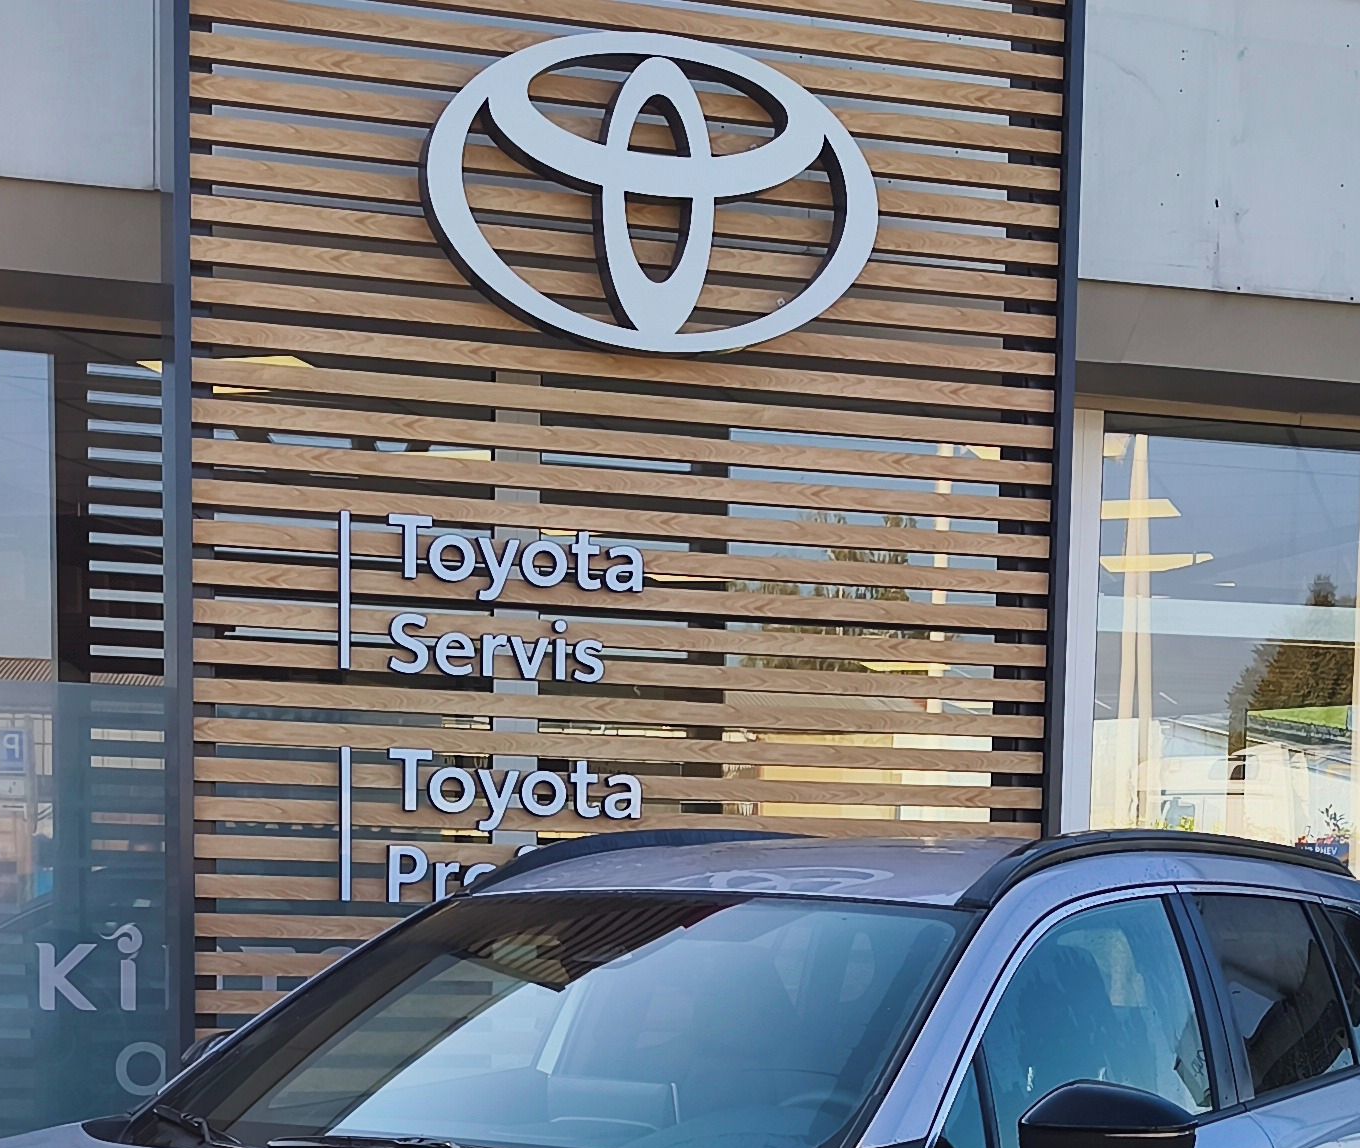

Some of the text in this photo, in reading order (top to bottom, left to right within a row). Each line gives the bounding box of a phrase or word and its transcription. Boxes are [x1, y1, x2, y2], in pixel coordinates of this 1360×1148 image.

[388, 513, 644, 601] Toyota
[388, 612, 605, 683] Servis
[388, 747, 643, 832] Toyota
